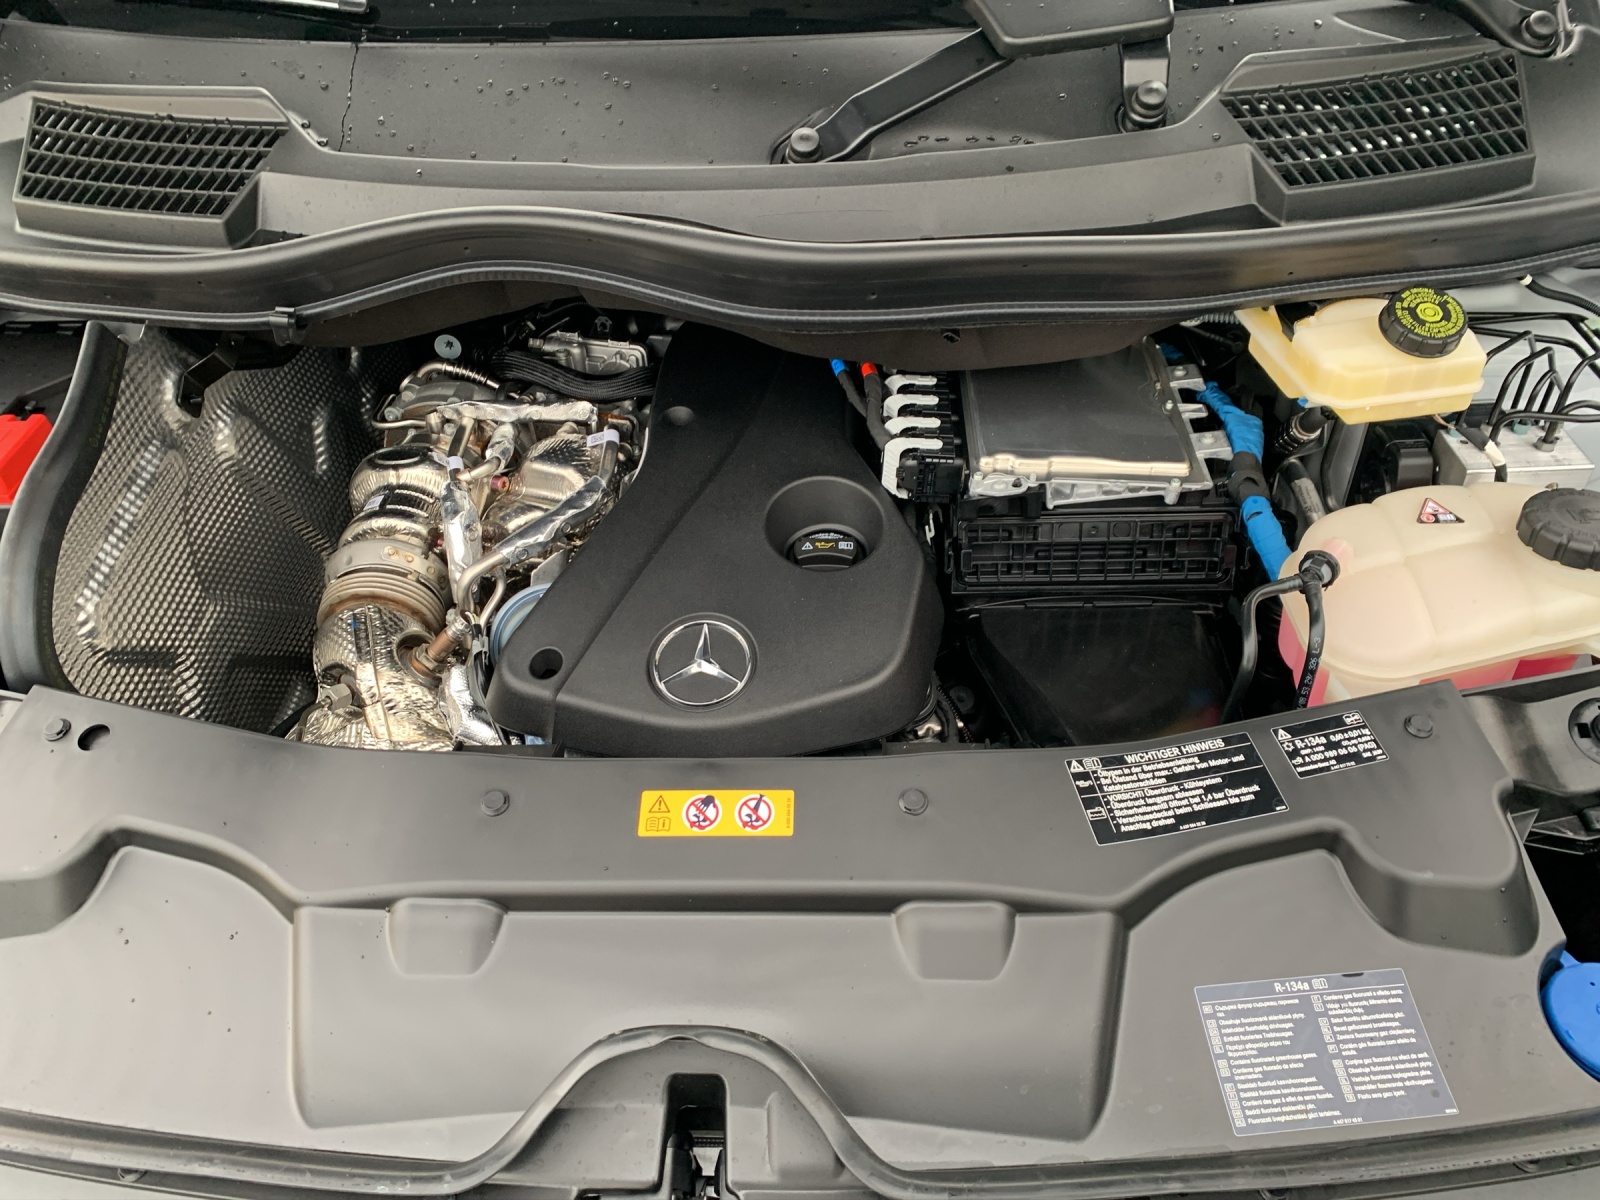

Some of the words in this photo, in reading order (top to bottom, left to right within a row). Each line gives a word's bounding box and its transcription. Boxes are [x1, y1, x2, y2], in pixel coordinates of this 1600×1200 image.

[1294, 736, 1328, 748] R-134a
[1330, 732, 1344, 742] 0,60
[1124, 747, 1181, 764] WICHTIGER
[1181, 738, 1225, 754] HINWEIS
[1310, 752, 1324, 761] 000
[1324, 750, 1338, 758] 989
[1338, 748, 1348, 756] 06
[1358, 742, 1378, 752] (PAG)
[1172, 764, 1196, 774] Gefahr
[1208, 758, 1231, 767] Motor-
[1232, 754, 1246, 762] und
[1144, 784, 1180, 796] Überdruck
[1188, 796, 1201, 804] bei
[1202, 793, 1213, 802] 1,4
[1212, 792, 1225, 800] bar
[1224, 784, 1261, 797] Überdruck
[1174, 806, 1193, 815] beim
[1228, 796, 1240, 804] bis
[1240, 794, 1256, 802] zum
[1121, 821, 1152, 832] Anschlag
[1151, 818, 1176, 828] drehen
[1274, 980, 1310, 993] R-134a
